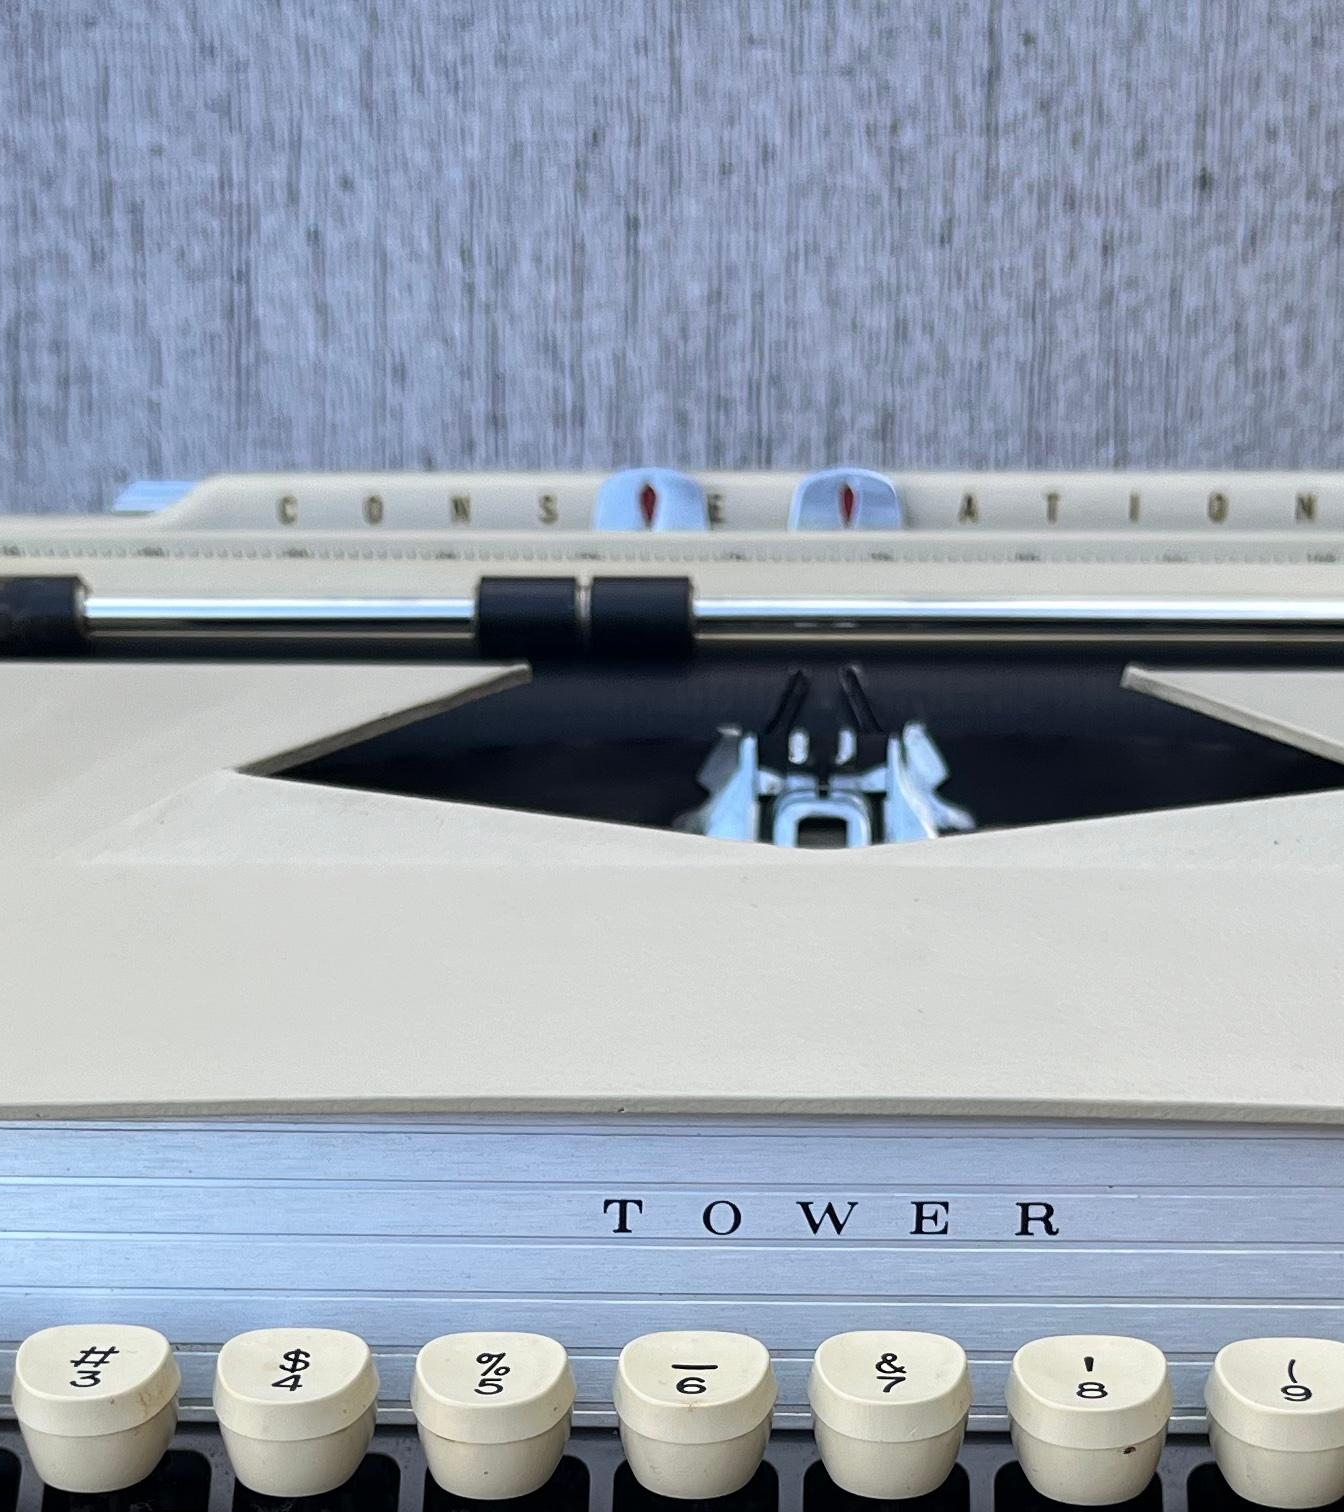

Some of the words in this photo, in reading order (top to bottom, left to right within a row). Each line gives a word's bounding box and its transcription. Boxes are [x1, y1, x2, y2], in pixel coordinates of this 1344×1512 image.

[274, 492, 1320, 526] CONSEATION
[604, 1200, 1059, 1235] TOWER
[70, 1346, 120, 1368] #
[278, 1348, 311, 1373] $
[475, 1352, 511, 1377] %
[875, 1352, 907, 1375] &
[69, 1370, 101, 1388] 3
[1287, 1358, 1298, 1384] (
[271, 1374, 303, 1392] 4
[473, 1377, 504, 1396] 5
[675, 1376, 707, 1395] 6
[876, 1375, 907, 1393] 7
[1076, 1381, 1109, 1400] 8
[1280, 1384, 1313, 1402] 9
